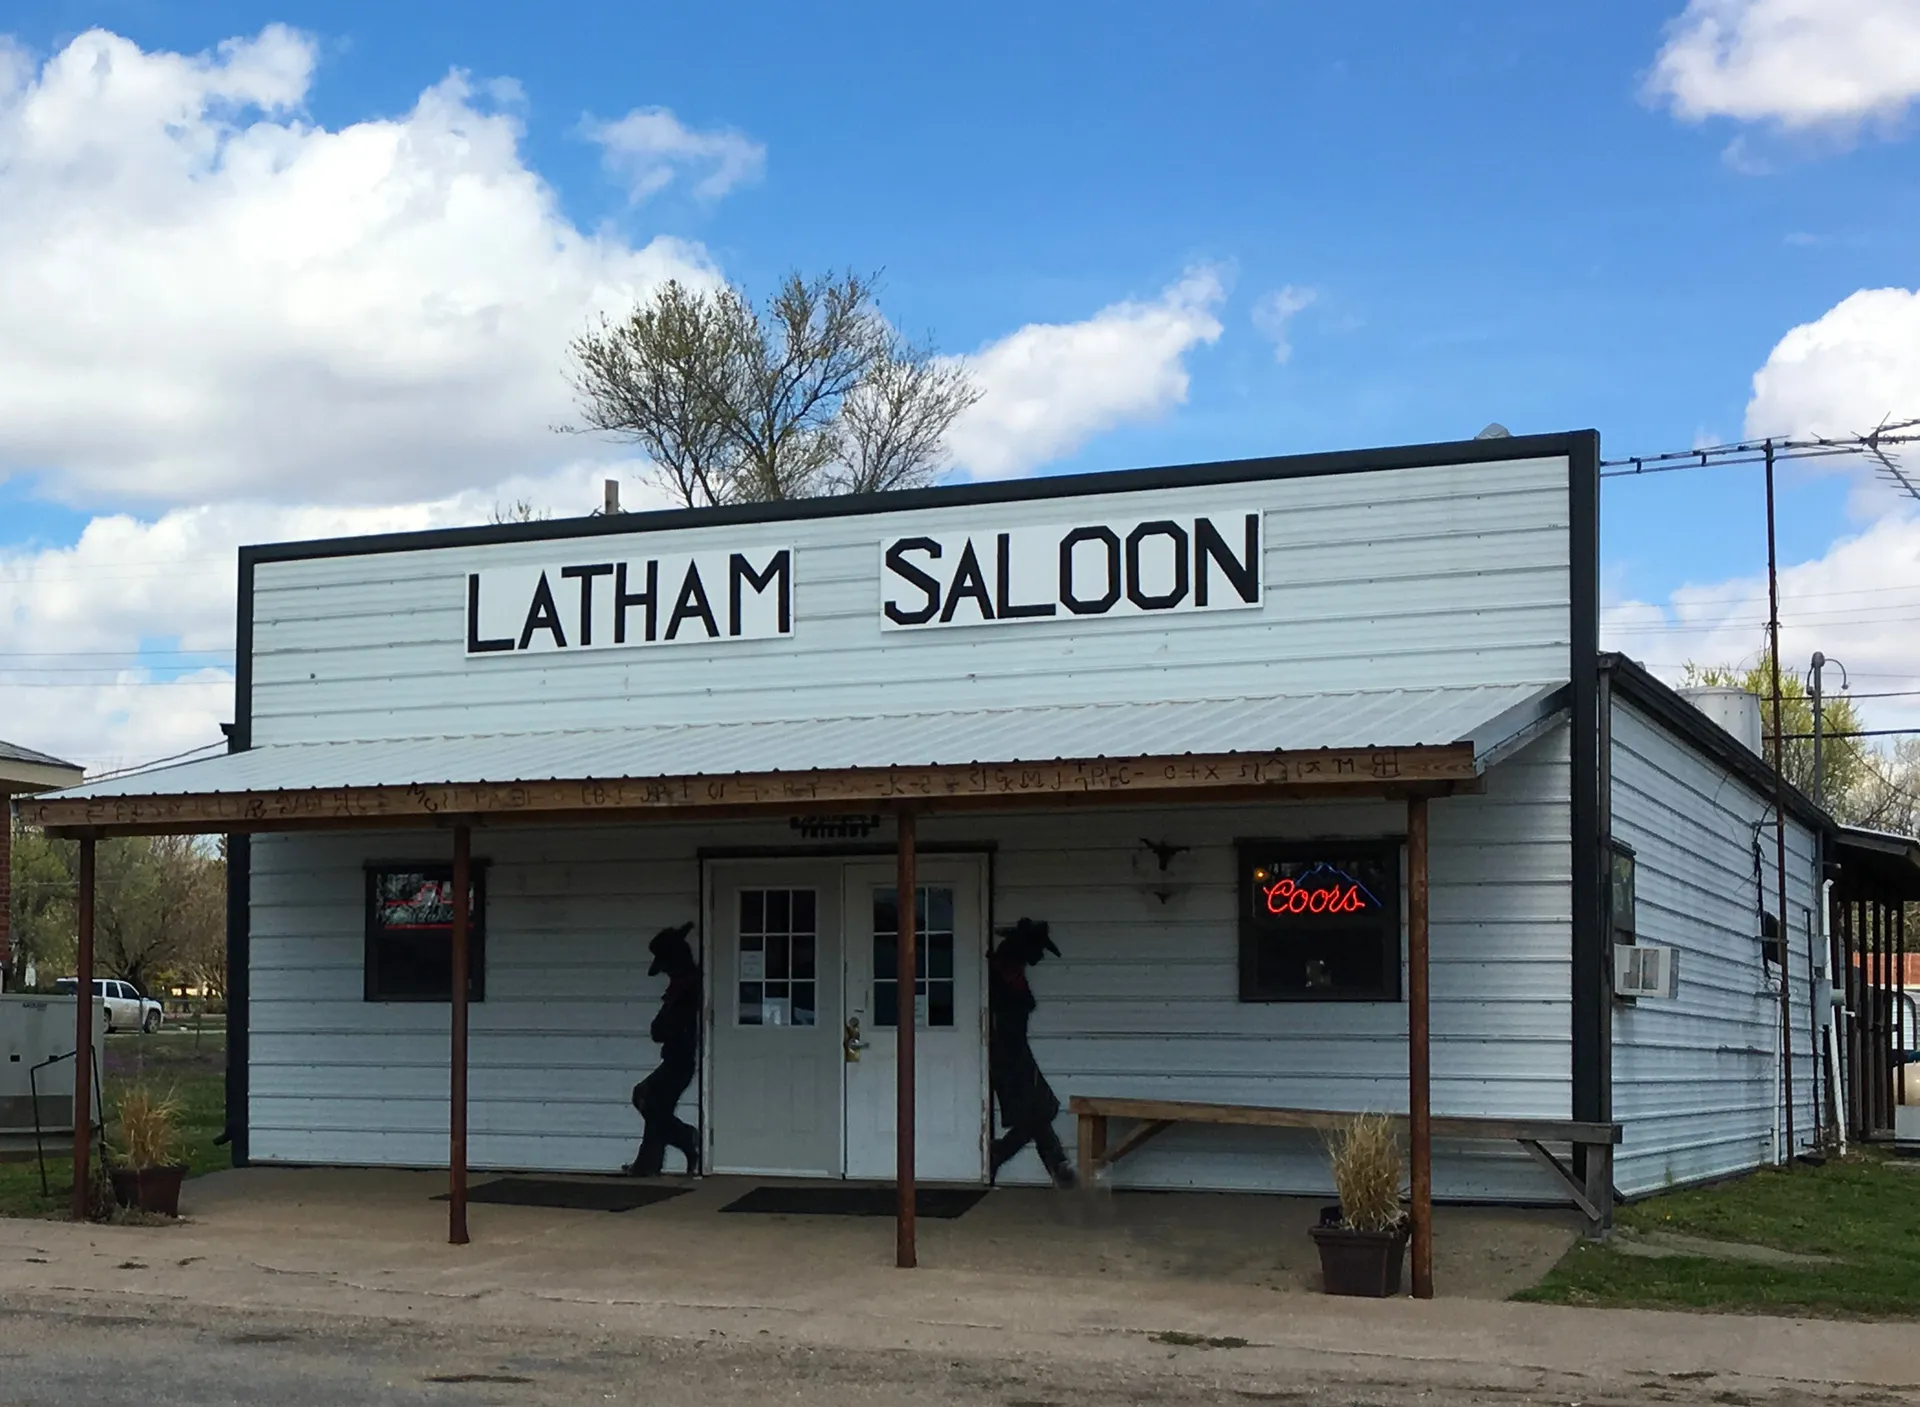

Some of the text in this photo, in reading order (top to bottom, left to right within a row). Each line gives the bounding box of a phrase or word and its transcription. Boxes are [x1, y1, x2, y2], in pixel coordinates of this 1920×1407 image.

[467, 513, 1260, 653] LATHAM SALOON
[1263, 879, 1366, 913] Coors
